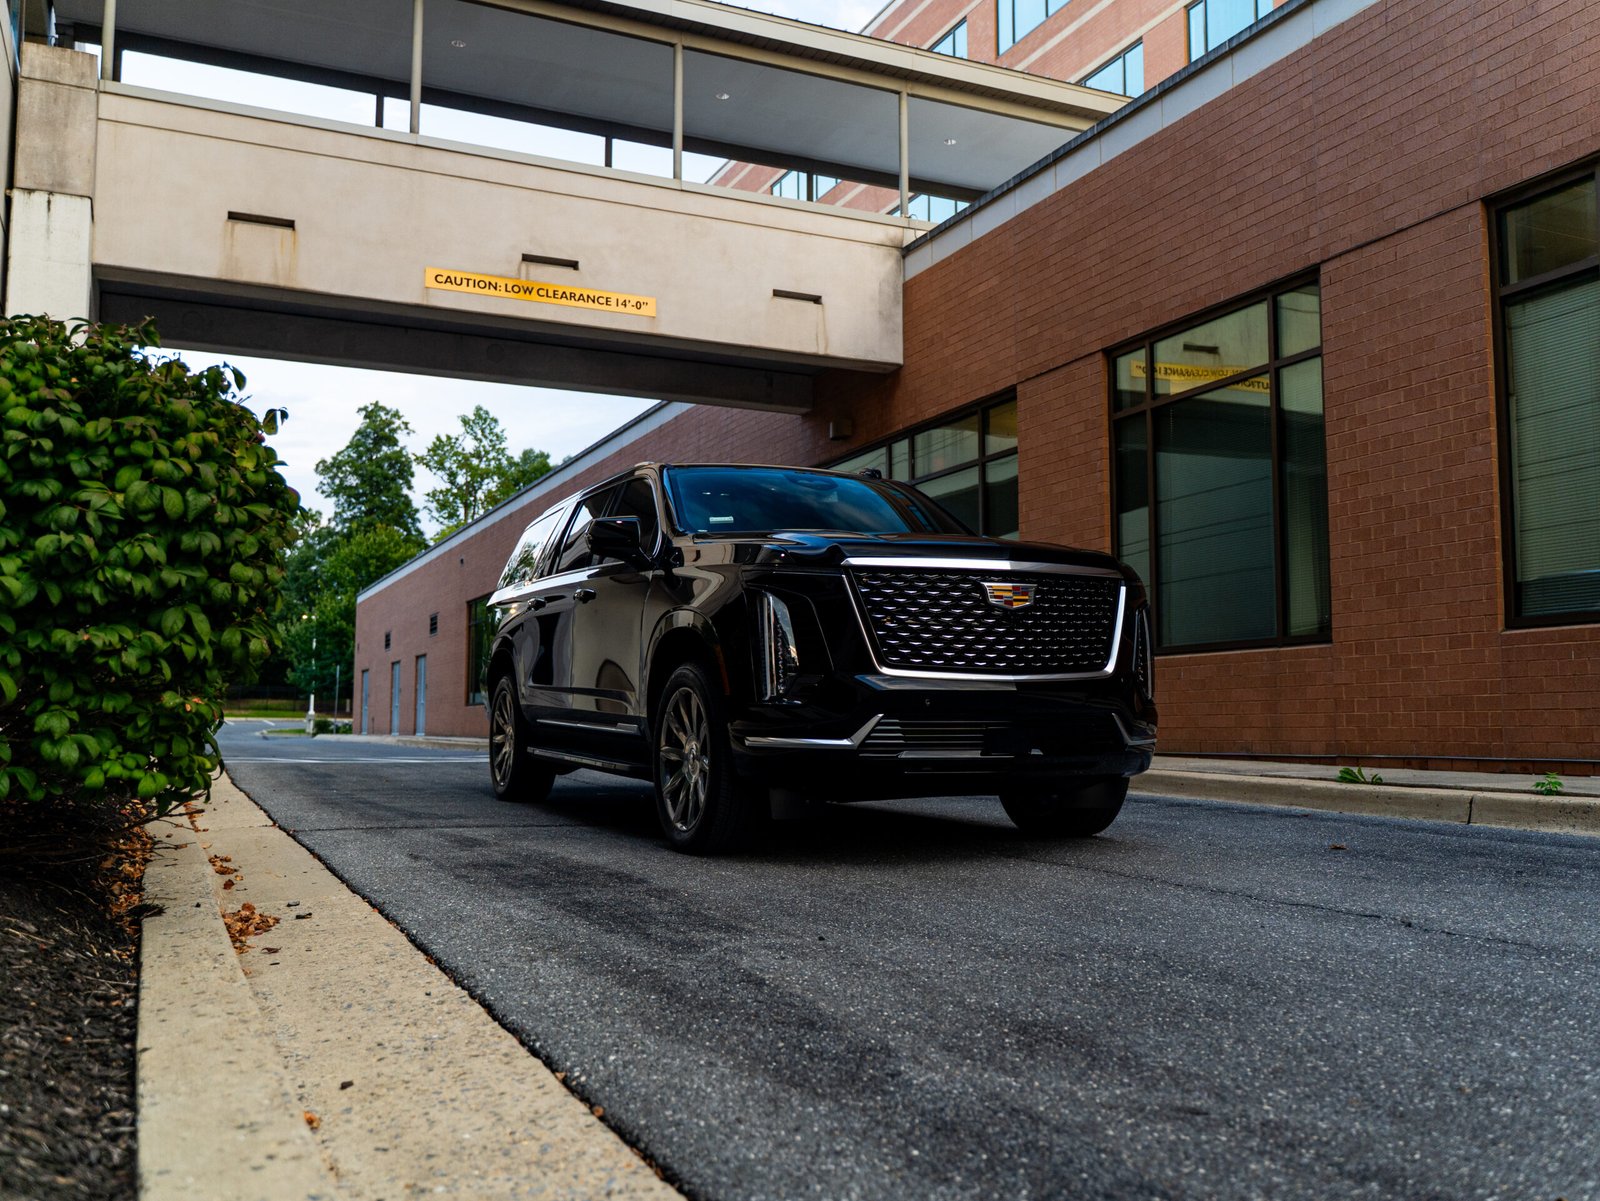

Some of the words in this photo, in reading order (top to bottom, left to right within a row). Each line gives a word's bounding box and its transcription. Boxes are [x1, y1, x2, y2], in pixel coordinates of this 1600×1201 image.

[434, 273, 502, 292] CAUTION:
[505, 283, 534, 296] LOW
[536, 287, 612, 307] CLEARANCE
